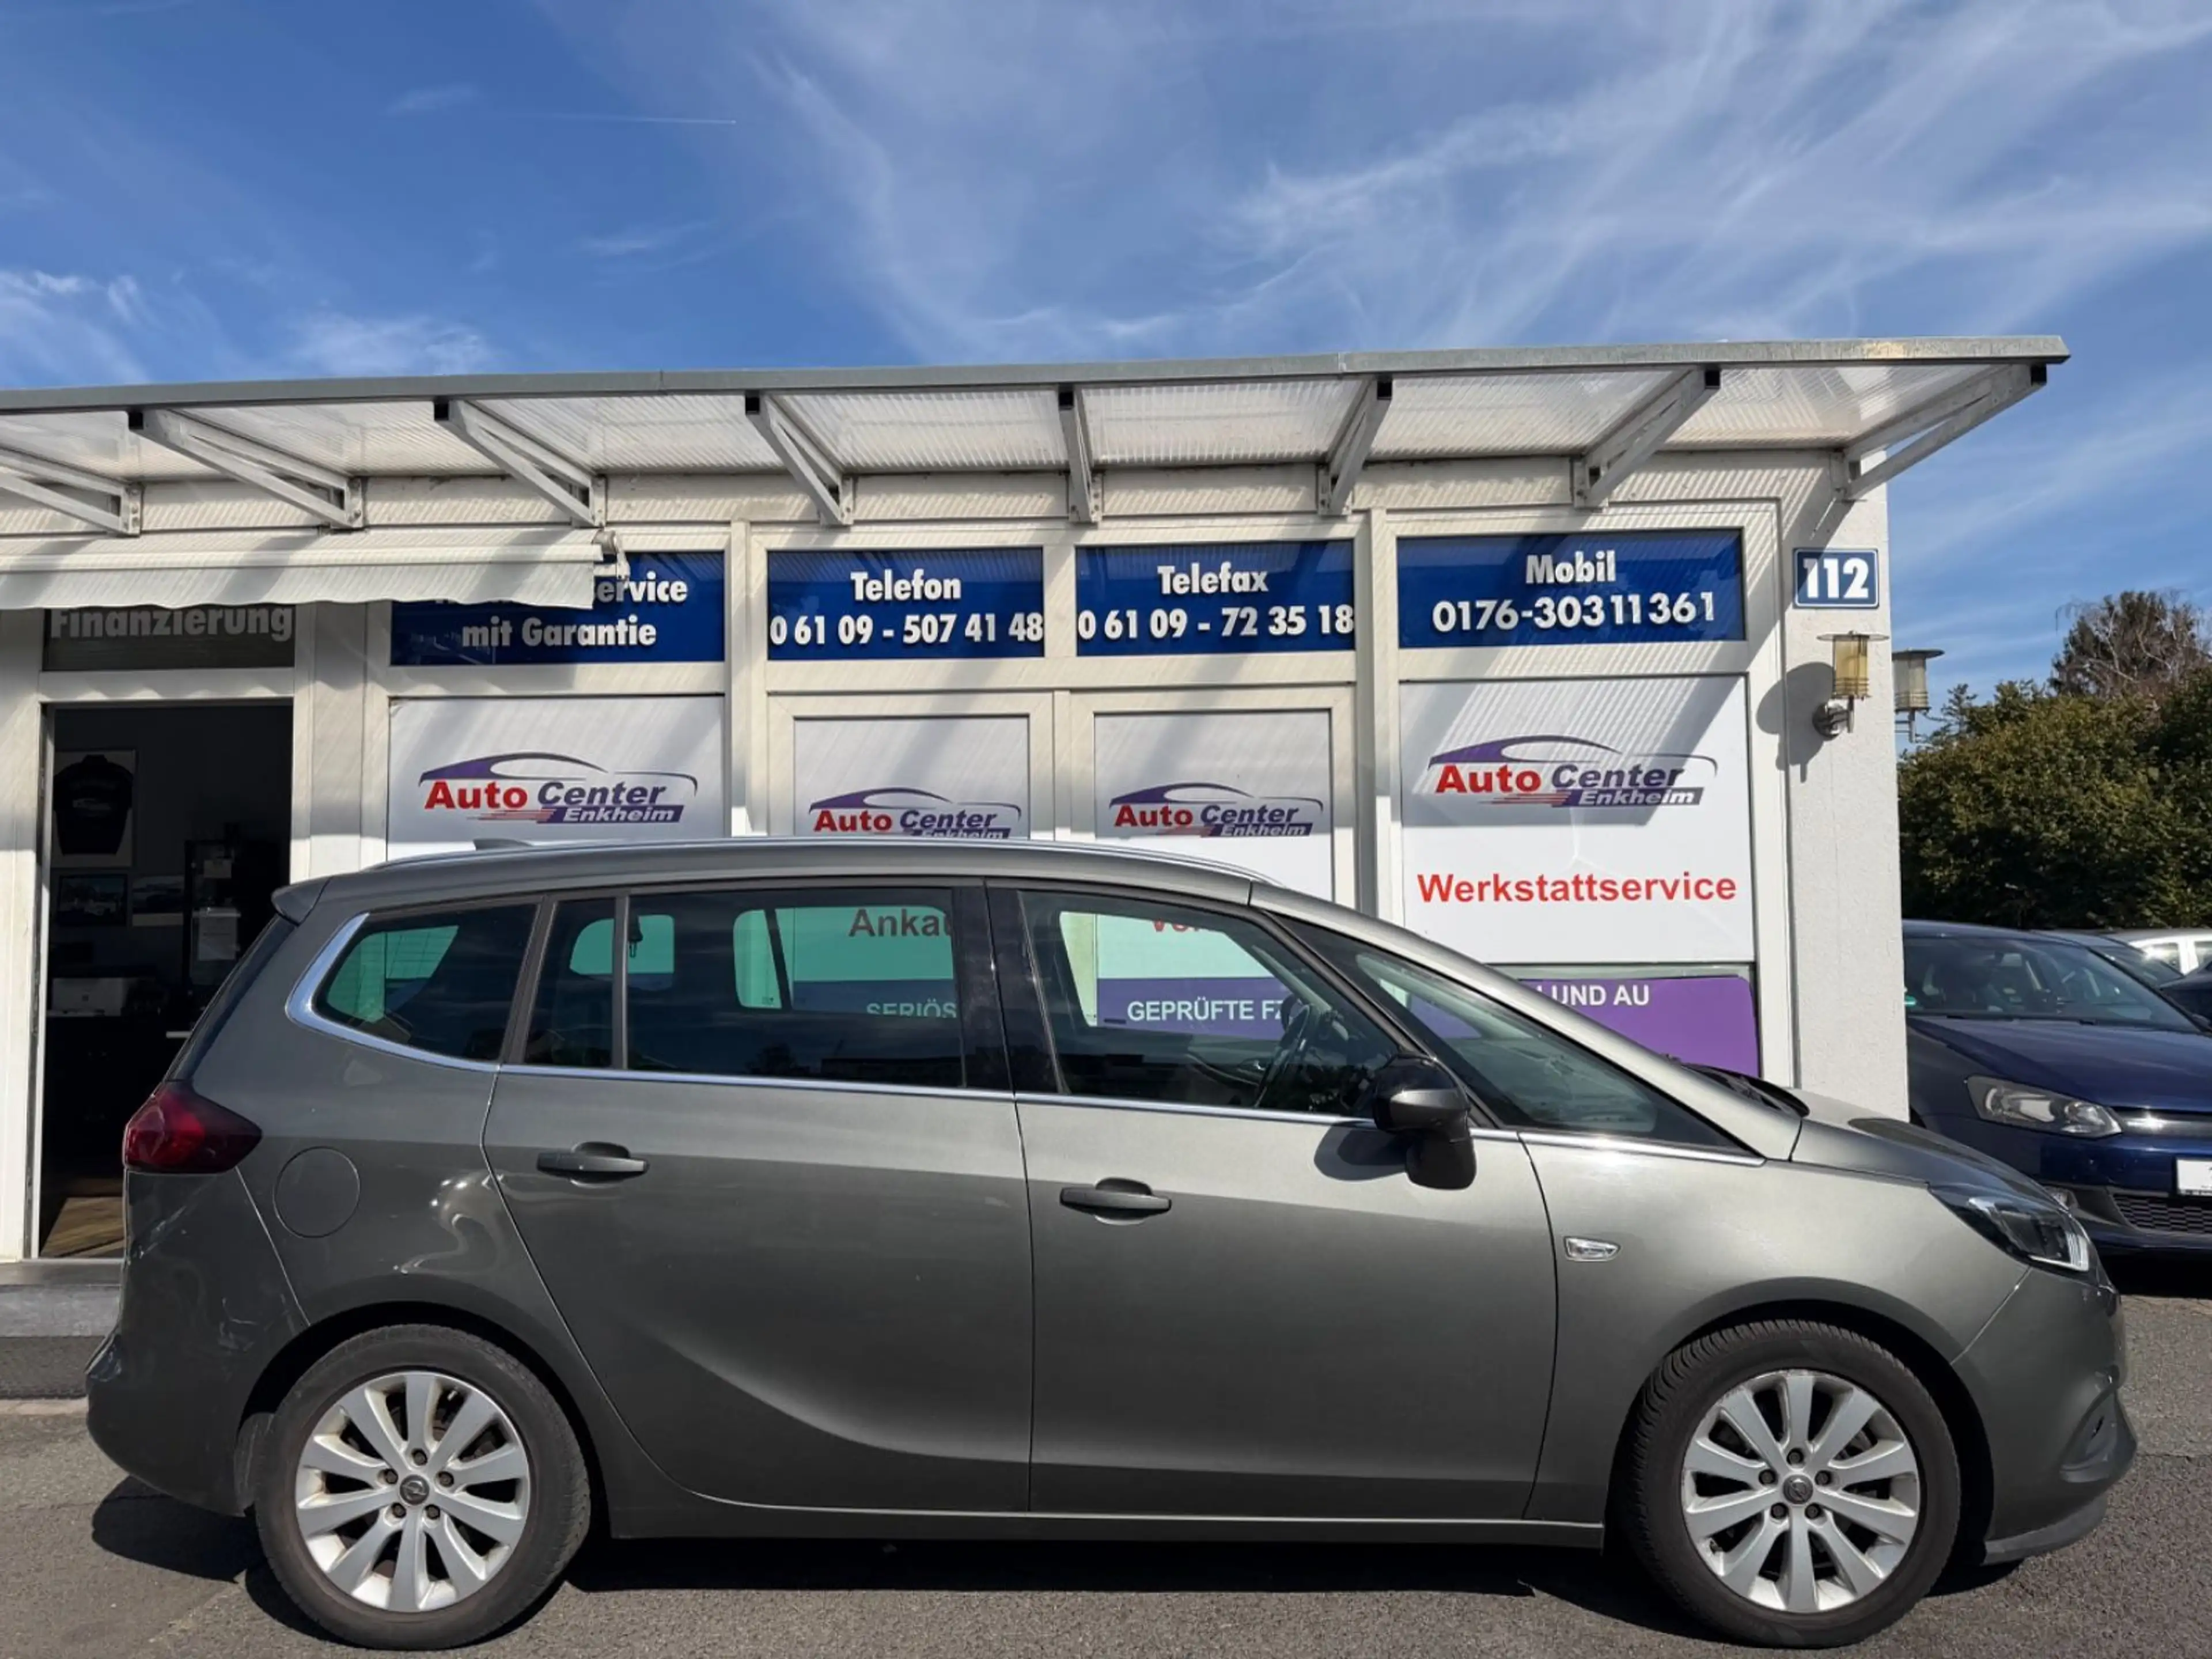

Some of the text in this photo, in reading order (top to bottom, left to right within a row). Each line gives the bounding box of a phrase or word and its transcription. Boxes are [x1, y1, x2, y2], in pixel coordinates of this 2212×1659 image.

[1157, 562, 1267, 594] Telefax
[1527, 550, 1615, 583] Mobil
[1802, 558, 1870, 599] 112
[597, 570, 688, 603] ervice
[850, 569, 961, 600] Telefon
[51, 607, 292, 642] Finanzierung
[461, 614, 657, 647] mit Garantie
[770, 616, 787, 644] 0
[794, 616, 825, 644] 61
[838, 615, 873, 644] 09
[903, 614, 956, 643] 507
[965, 614, 995, 641] 41
[1009, 613, 1043, 641] 48
[1078, 611, 1096, 639] 0
[1104, 610, 1137, 638] 61
[1150, 609, 1187, 638] 09
[1222, 607, 1257, 635] 72
[1269, 606, 1306, 635] 35
[1319, 605, 1353, 633] 18
[1435, 763, 1686, 793] Auto Center
[424, 781, 666, 810] Auto Center
[1578, 789, 1695, 806] Enkheim
[563, 806, 675, 824] Enkheim
[813, 809, 997, 832] Auto Center
[1115, 804, 1300, 828] Auto Center
[1219, 824, 1306, 837] Enkheim
[1416, 871, 1738, 904] Werkstattservice
[1127, 997, 1255, 1021] GEPRÜFTE
[1551, 984, 1650, 1006] UND AU
